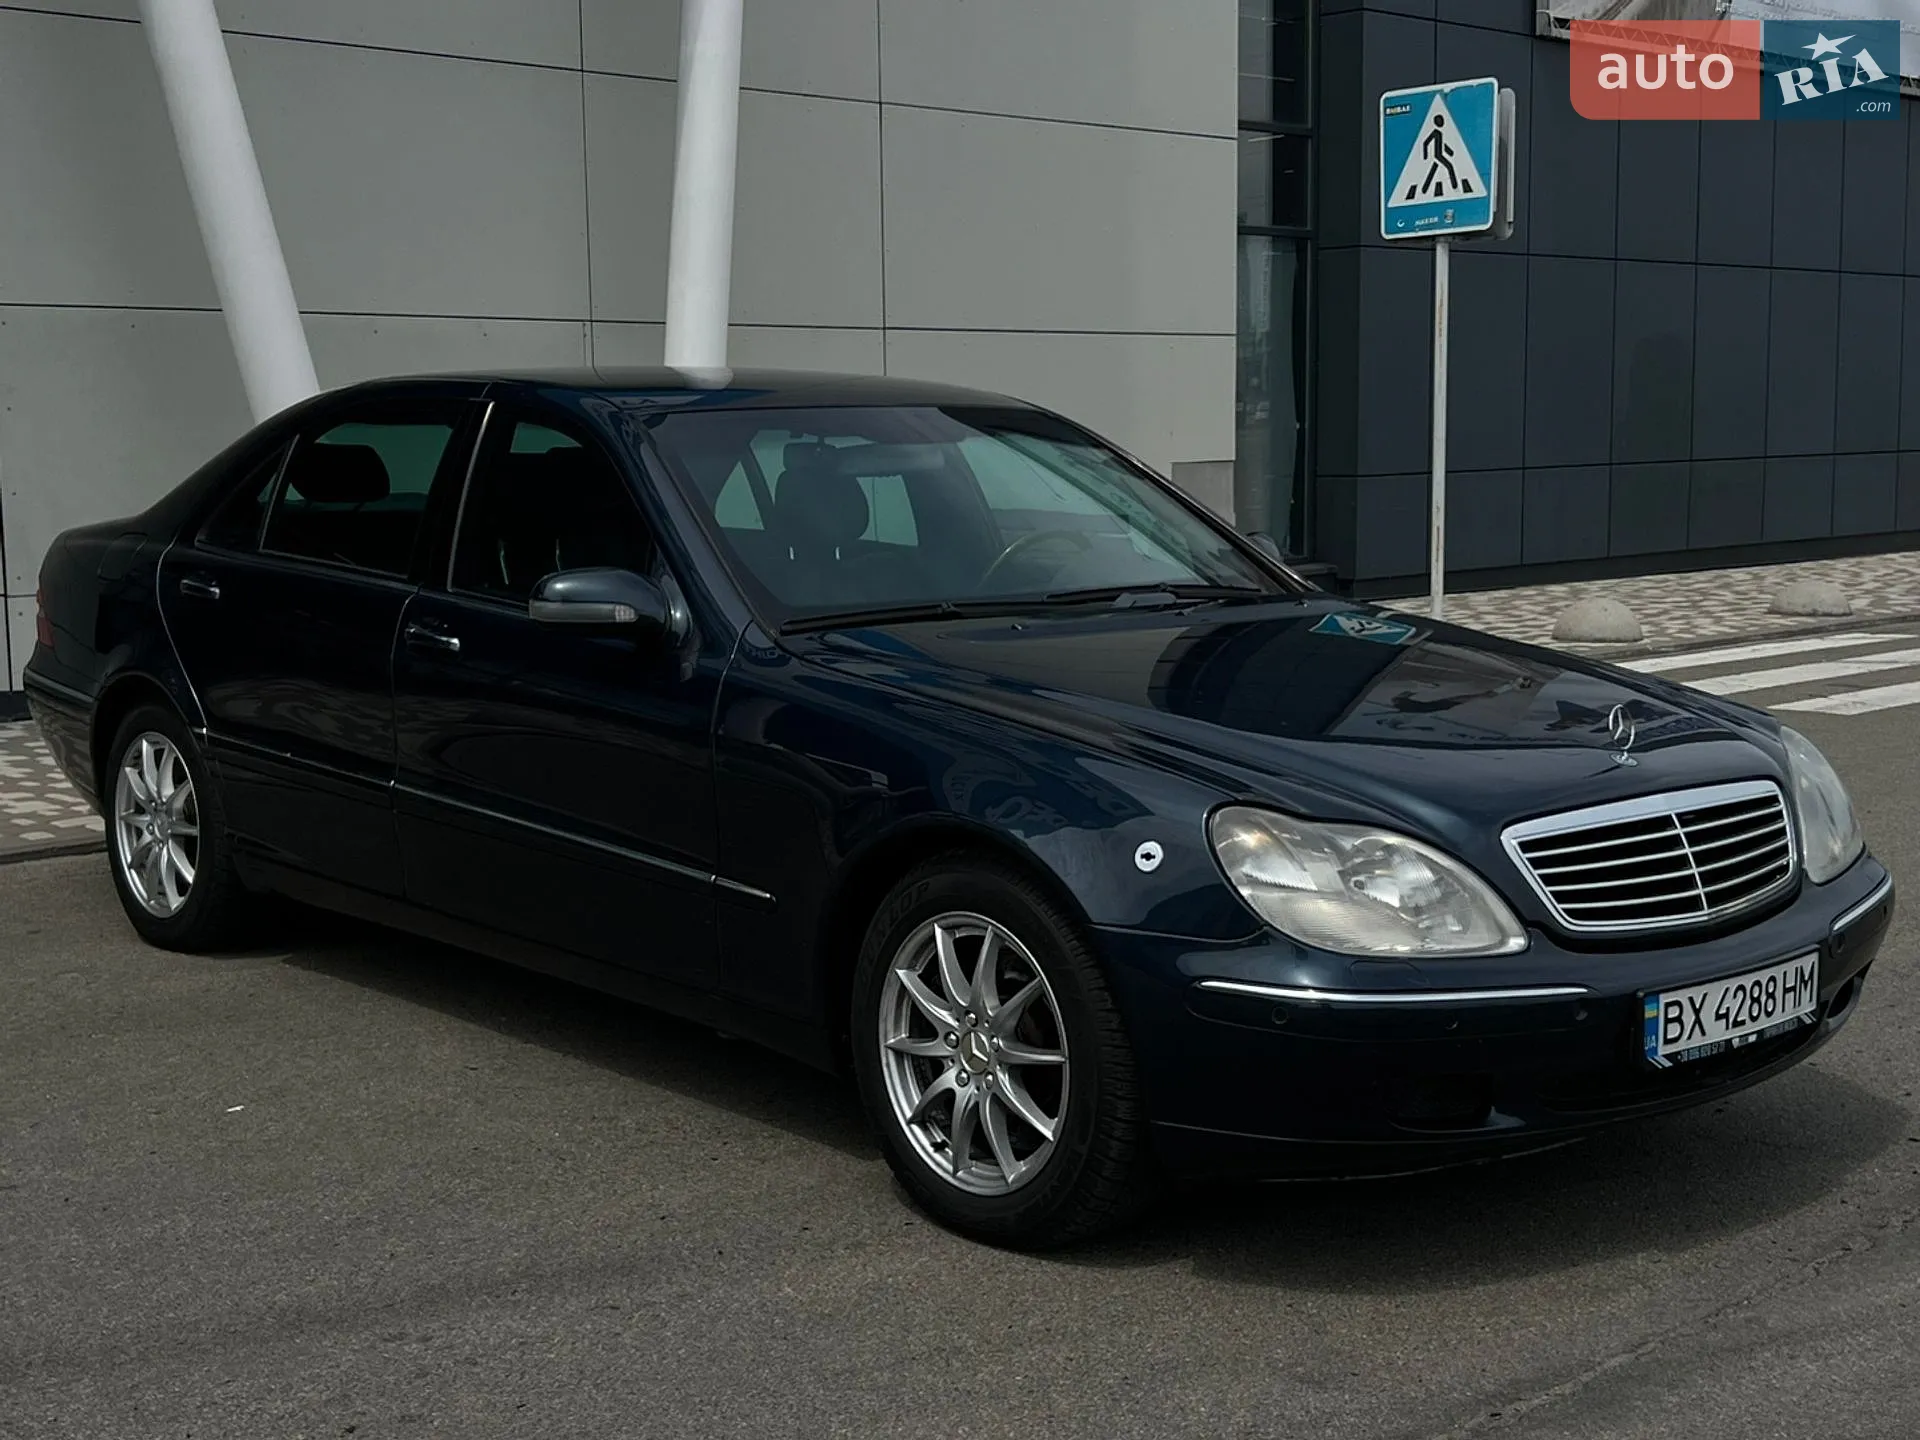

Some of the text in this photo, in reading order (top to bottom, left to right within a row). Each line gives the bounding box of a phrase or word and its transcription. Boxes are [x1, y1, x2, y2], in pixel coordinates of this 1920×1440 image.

[1663, 961, 1815, 1045] BX 4288 HM
